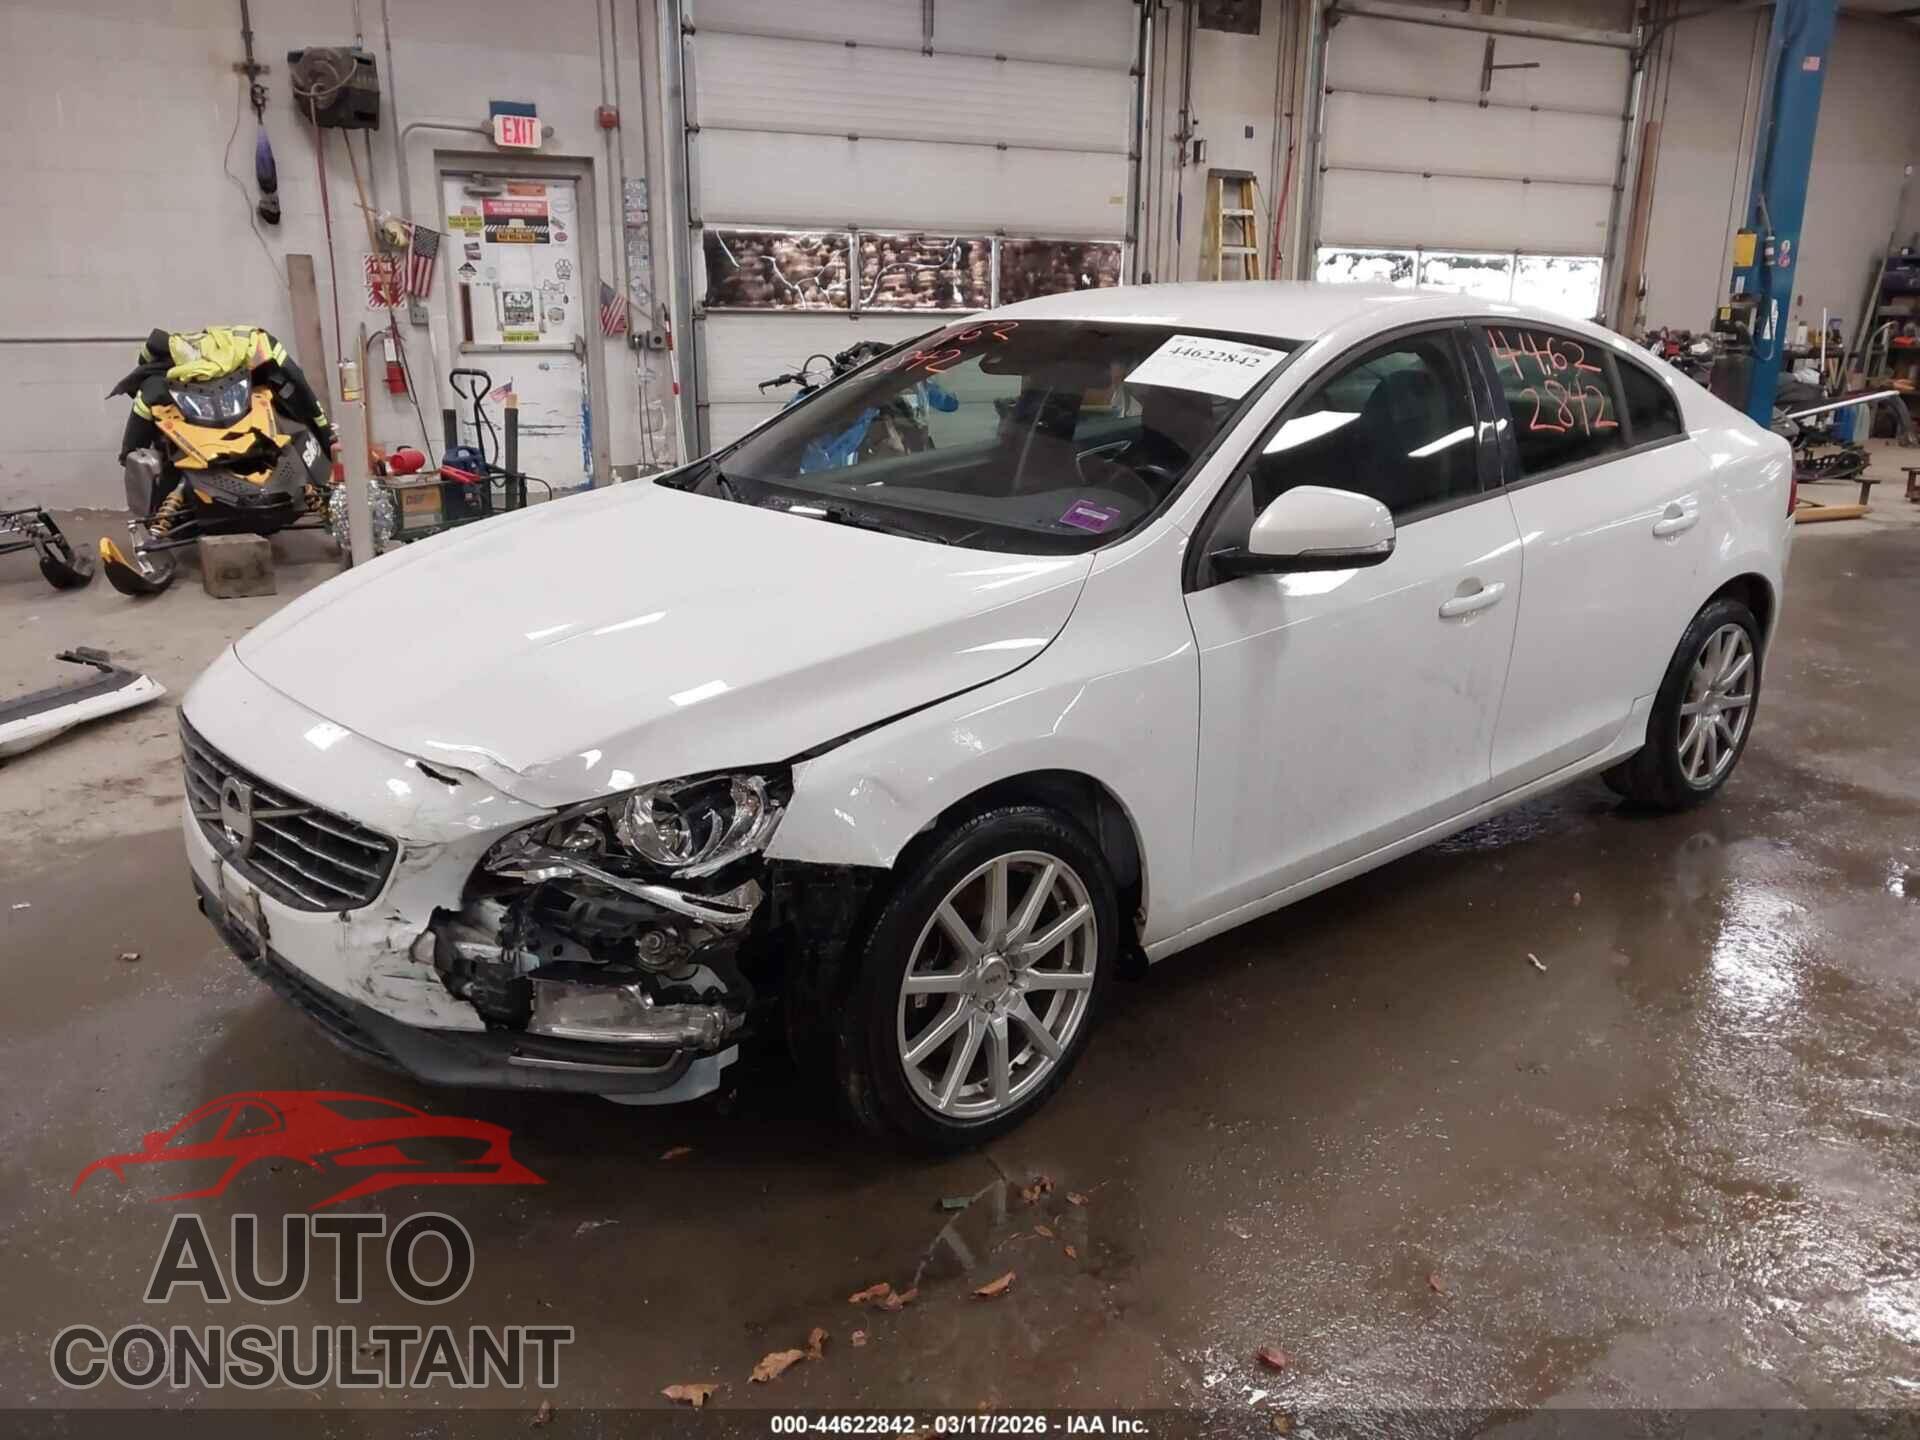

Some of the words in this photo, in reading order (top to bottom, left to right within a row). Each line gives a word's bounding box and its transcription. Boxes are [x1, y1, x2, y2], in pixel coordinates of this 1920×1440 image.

[503, 117, 535, 144] EXIT
[1169, 346, 1261, 368] 44622842
[1488, 329, 1602, 380] 4462
[1520, 369, 1618, 436] 2842
